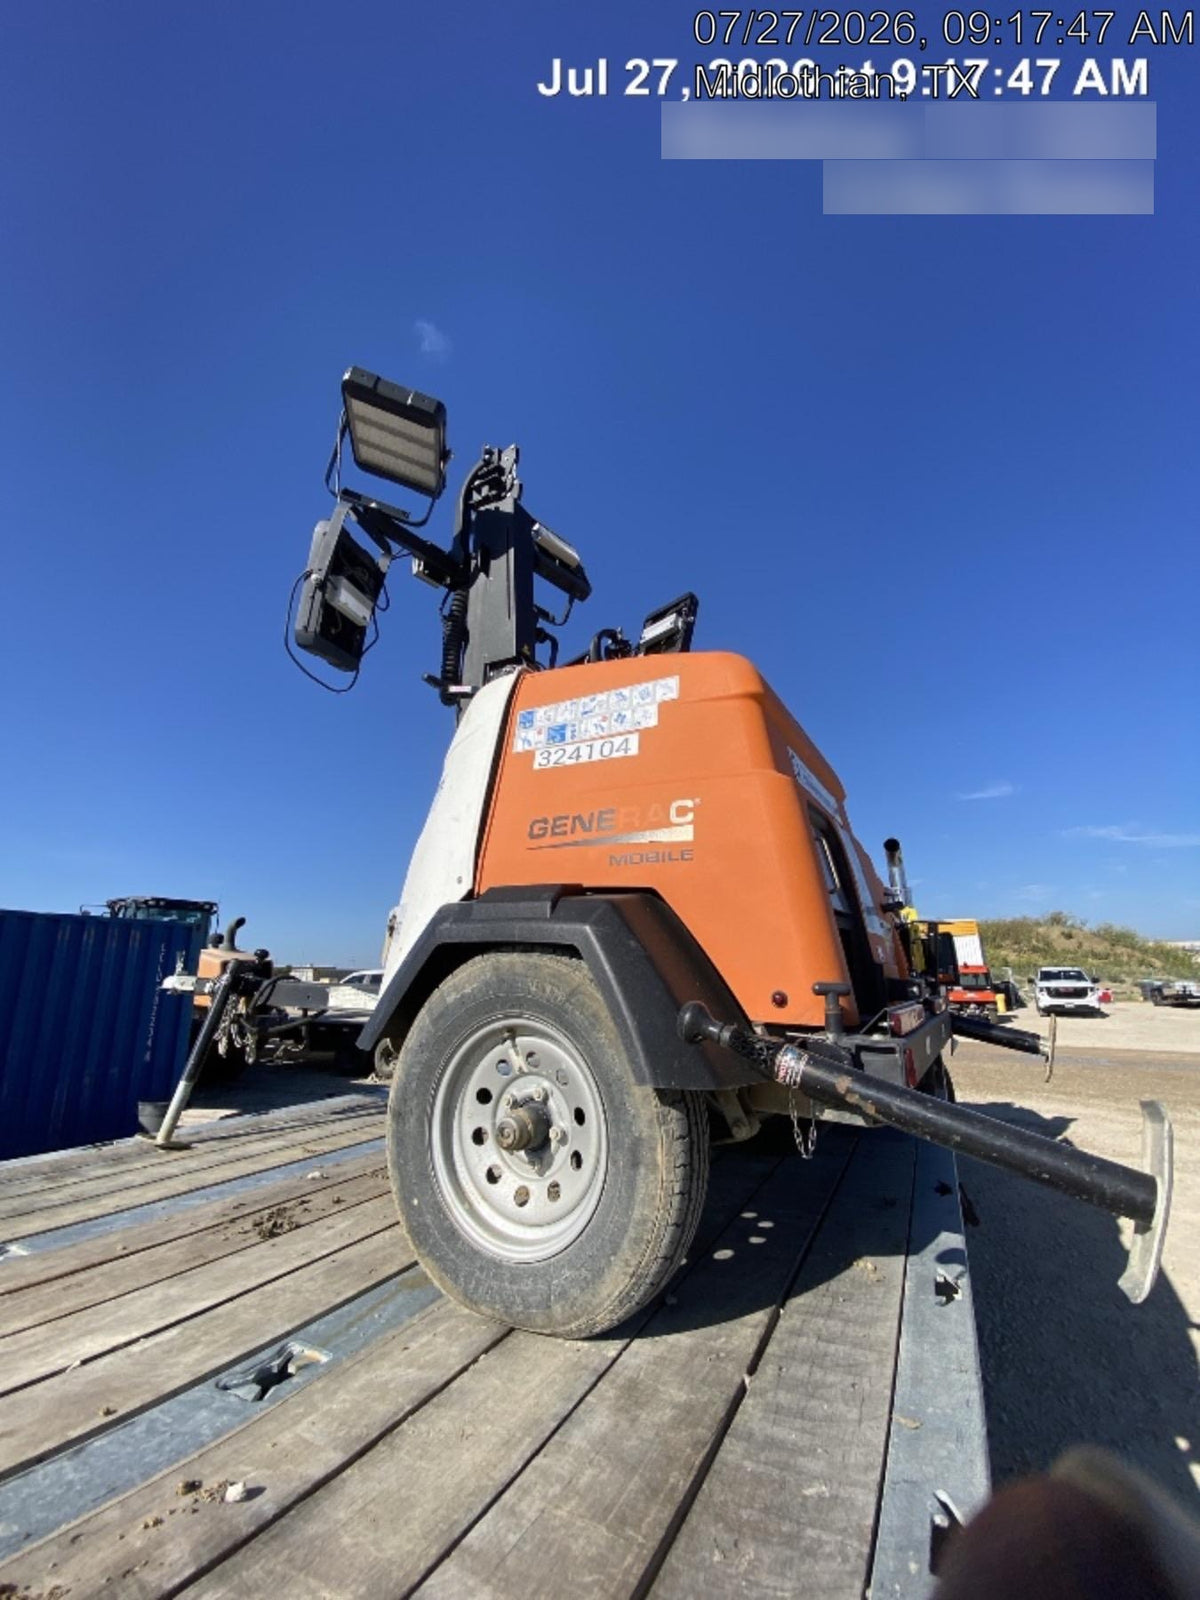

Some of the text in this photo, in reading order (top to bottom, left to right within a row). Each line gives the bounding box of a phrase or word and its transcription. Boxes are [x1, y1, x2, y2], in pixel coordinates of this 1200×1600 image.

[537, 737, 631, 768] 324104
[527, 799, 695, 840] GENERAC
[608, 849, 694, 867] MOBILE
